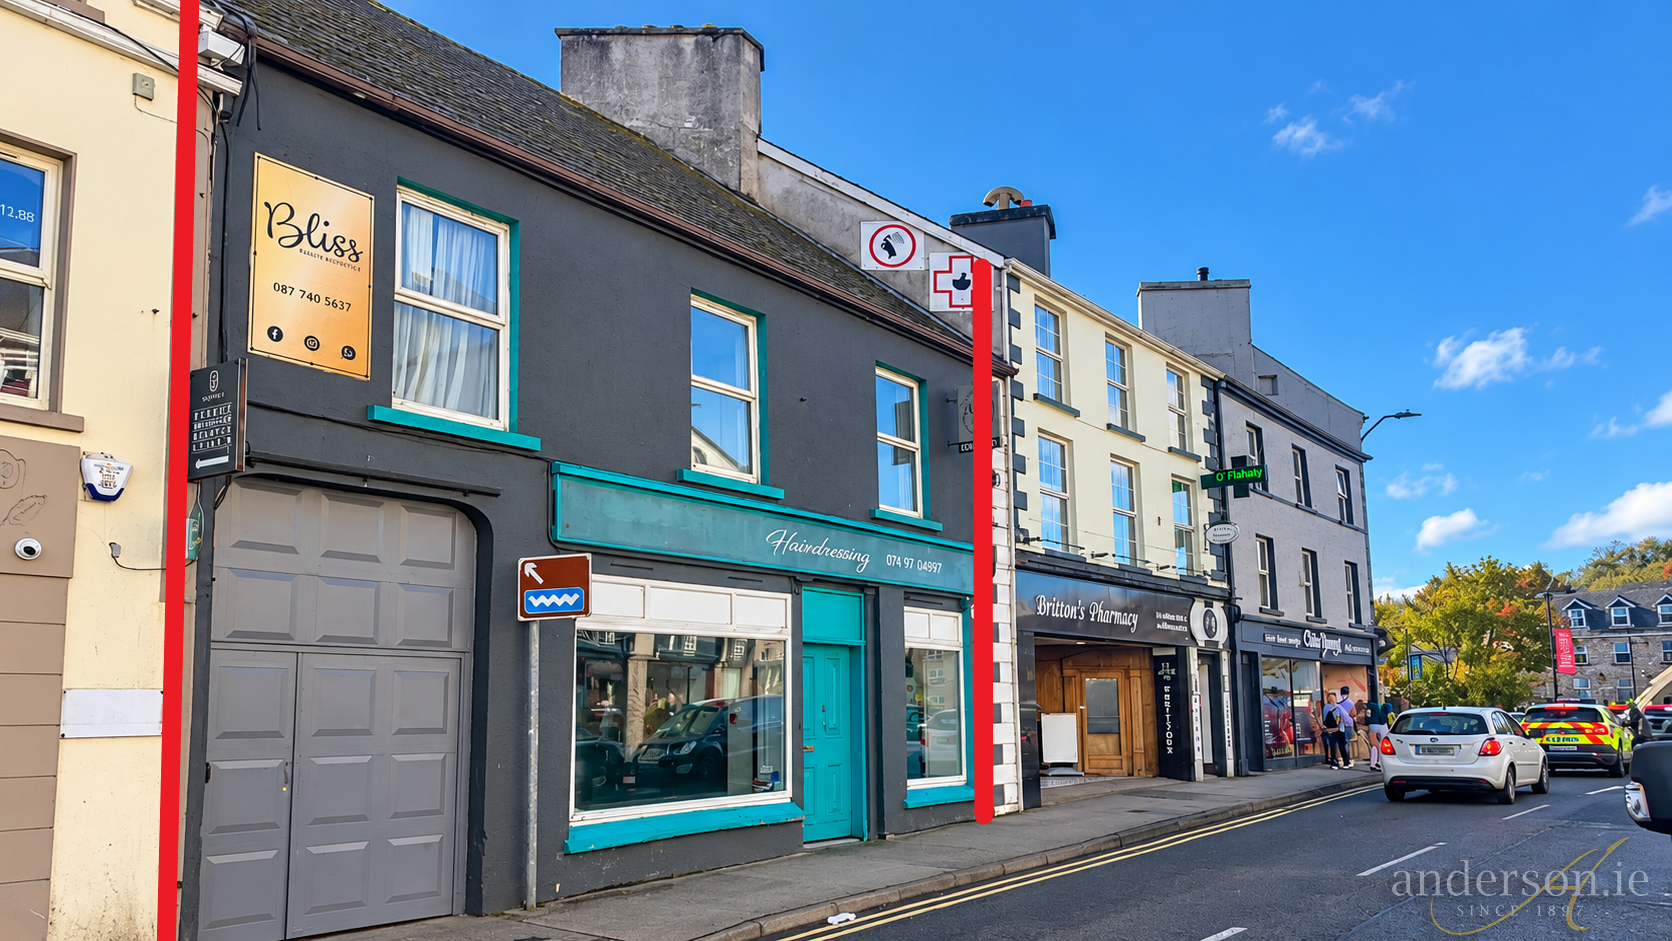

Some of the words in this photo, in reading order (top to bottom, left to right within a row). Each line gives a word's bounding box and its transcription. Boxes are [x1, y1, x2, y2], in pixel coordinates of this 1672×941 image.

[263, 201, 364, 263] Bliss
[273, 282, 295, 296] 087
[299, 289, 321, 304] 740
[324, 296, 352, 312] 5637
[765, 529, 871, 573] Hairdressing
[886, 554, 901, 568] 074
[903, 557, 914, 571] 97
[916, 559, 942, 574] 04997
[1035, 594, 1086, 621] Britton's
[1089, 600, 1139, 634] Pharmacy
